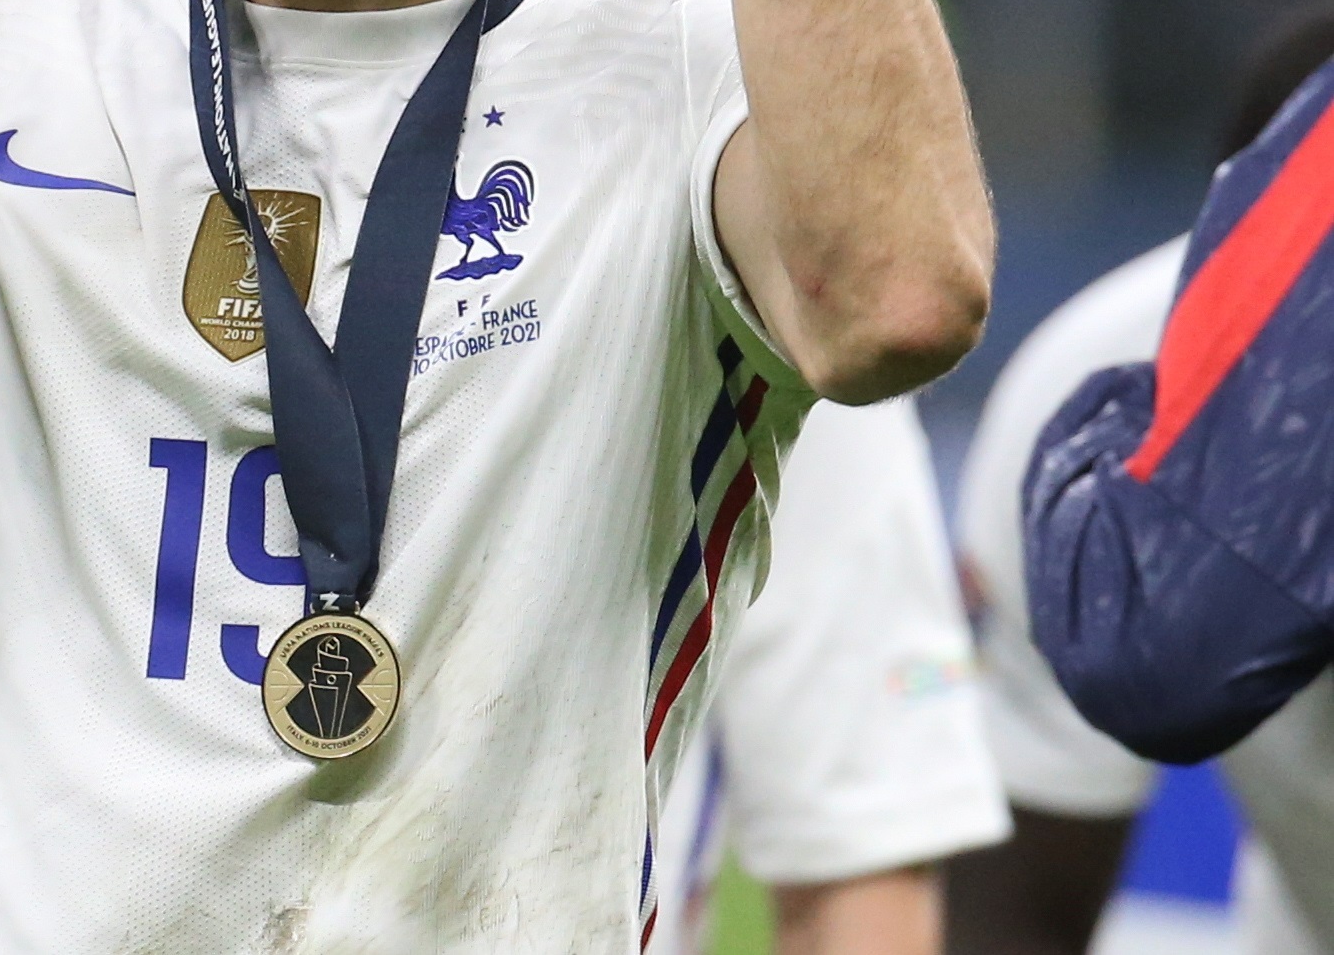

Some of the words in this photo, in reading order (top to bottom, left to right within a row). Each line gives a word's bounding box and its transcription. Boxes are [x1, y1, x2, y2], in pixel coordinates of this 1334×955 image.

[200, 318, 231, 327] WORLD
[482, 299, 538, 330] FRANCE
[223, 328, 255, 341] 2018
[413, 359, 430, 376] 10
[500, 321, 541, 346] 2021
[146, 438, 308, 686] 19
[297, 622, 331, 641] NATIONS
[332, 622, 362, 635] LEAGUE
